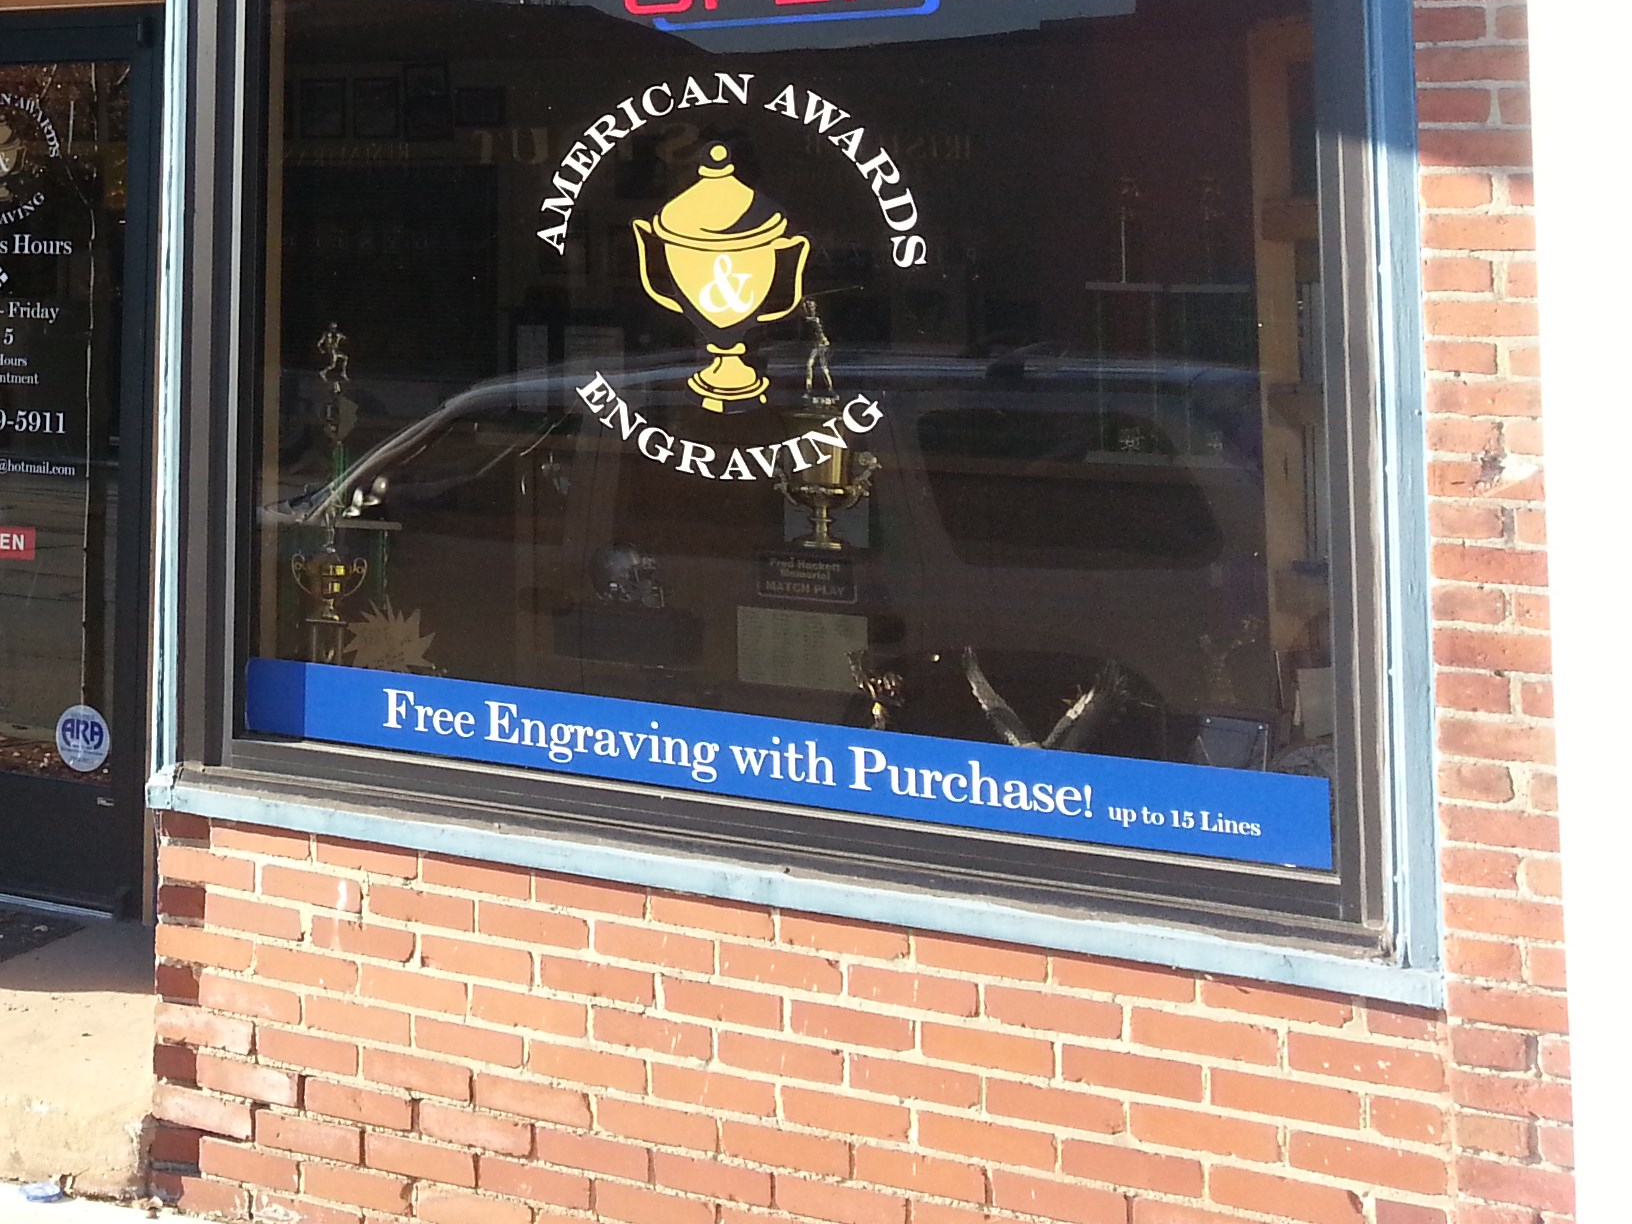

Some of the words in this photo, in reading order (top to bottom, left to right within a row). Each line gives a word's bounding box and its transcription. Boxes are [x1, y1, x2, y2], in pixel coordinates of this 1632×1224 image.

[15, 97, 59, 158] AWARDS
[536, 72, 755, 256] AMERICAN
[764, 83, 928, 270] AWARDS
[12, 234, 73, 255] Hours
[8, 301, 60, 324] Friday
[698, 253, 754, 314] &
[3, 328, 14, 345] 5
[575, 370, 886, 482] ENGRAVING
[382, 688, 476, 738] Free
[484, 700, 720, 784] Engraving
[729, 737, 837, 787] with
[848, 746, 1094, 818] Purchase!
[1107, 806, 1137, 827] up
[1141, 806, 1165, 826] to
[1169, 810, 1195, 830] 15
[1200, 811, 1262, 837] Lines
